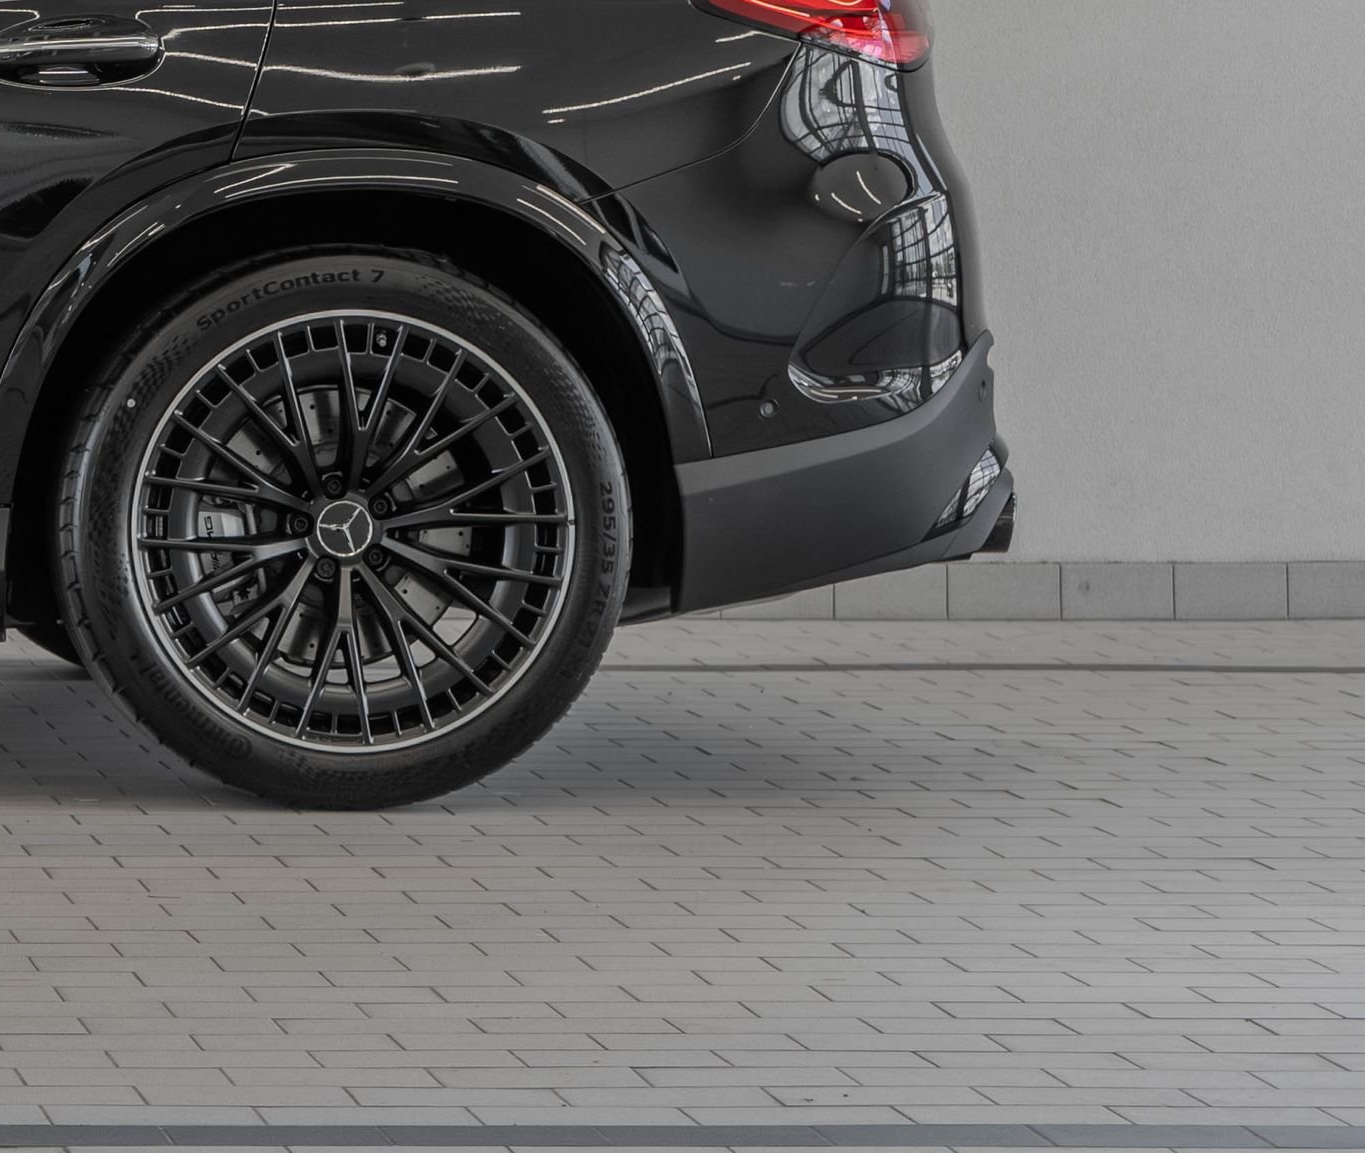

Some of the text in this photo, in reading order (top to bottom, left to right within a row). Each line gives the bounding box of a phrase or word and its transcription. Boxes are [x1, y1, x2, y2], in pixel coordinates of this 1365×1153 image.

[196, 269, 385, 330] SportContact 7
[599, 481, 617, 576] 295/35
